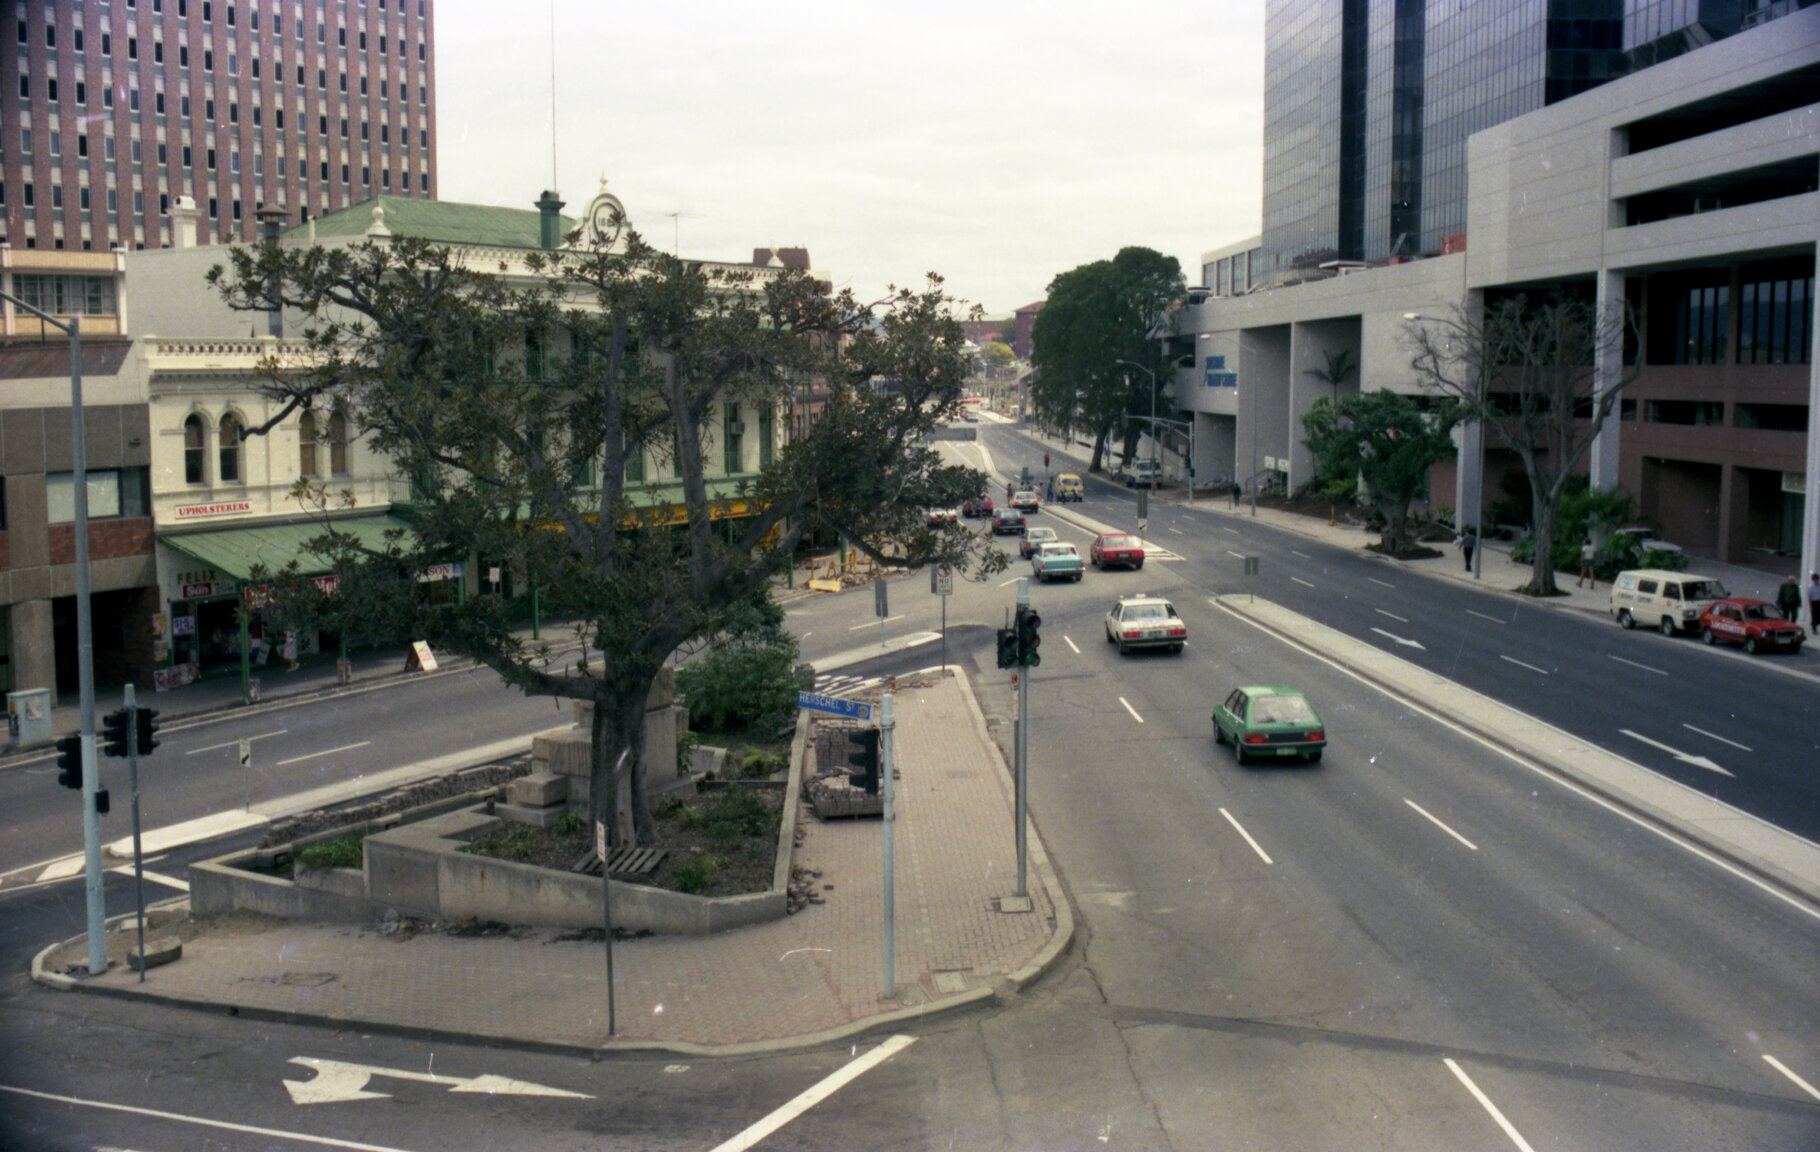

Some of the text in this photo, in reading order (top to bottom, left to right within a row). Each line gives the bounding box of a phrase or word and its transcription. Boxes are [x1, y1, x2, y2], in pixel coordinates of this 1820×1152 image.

[178, 502, 250, 516] UPHOLSTERERS
[177, 569, 216, 585] FELIX
[799, 692, 840, 710] HERSCHEL
